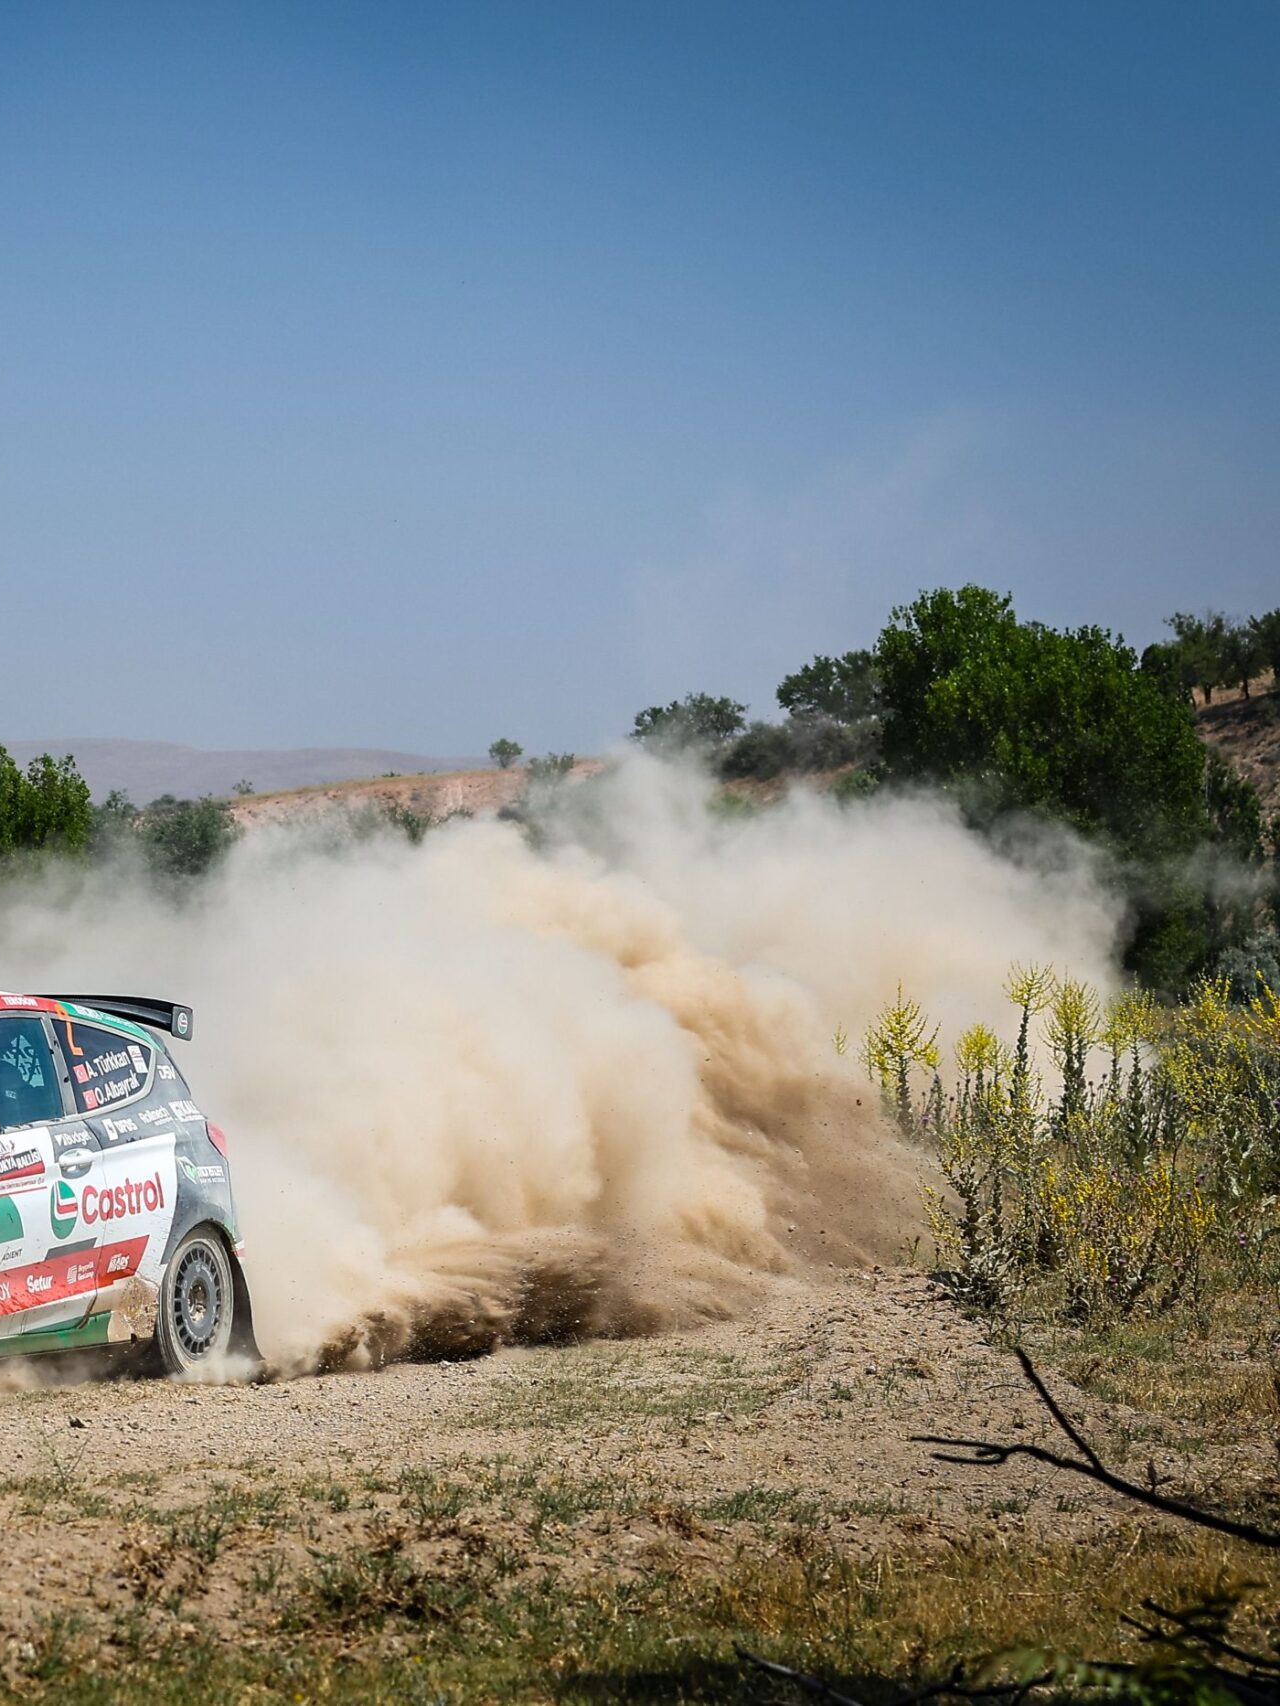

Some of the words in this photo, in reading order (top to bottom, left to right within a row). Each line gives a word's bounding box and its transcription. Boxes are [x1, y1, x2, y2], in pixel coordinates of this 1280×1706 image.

[93, 1050, 131, 1076] Türkkan
[81, 1171, 165, 1225] Castrol
[26, 1274, 54, 1294] Setur
